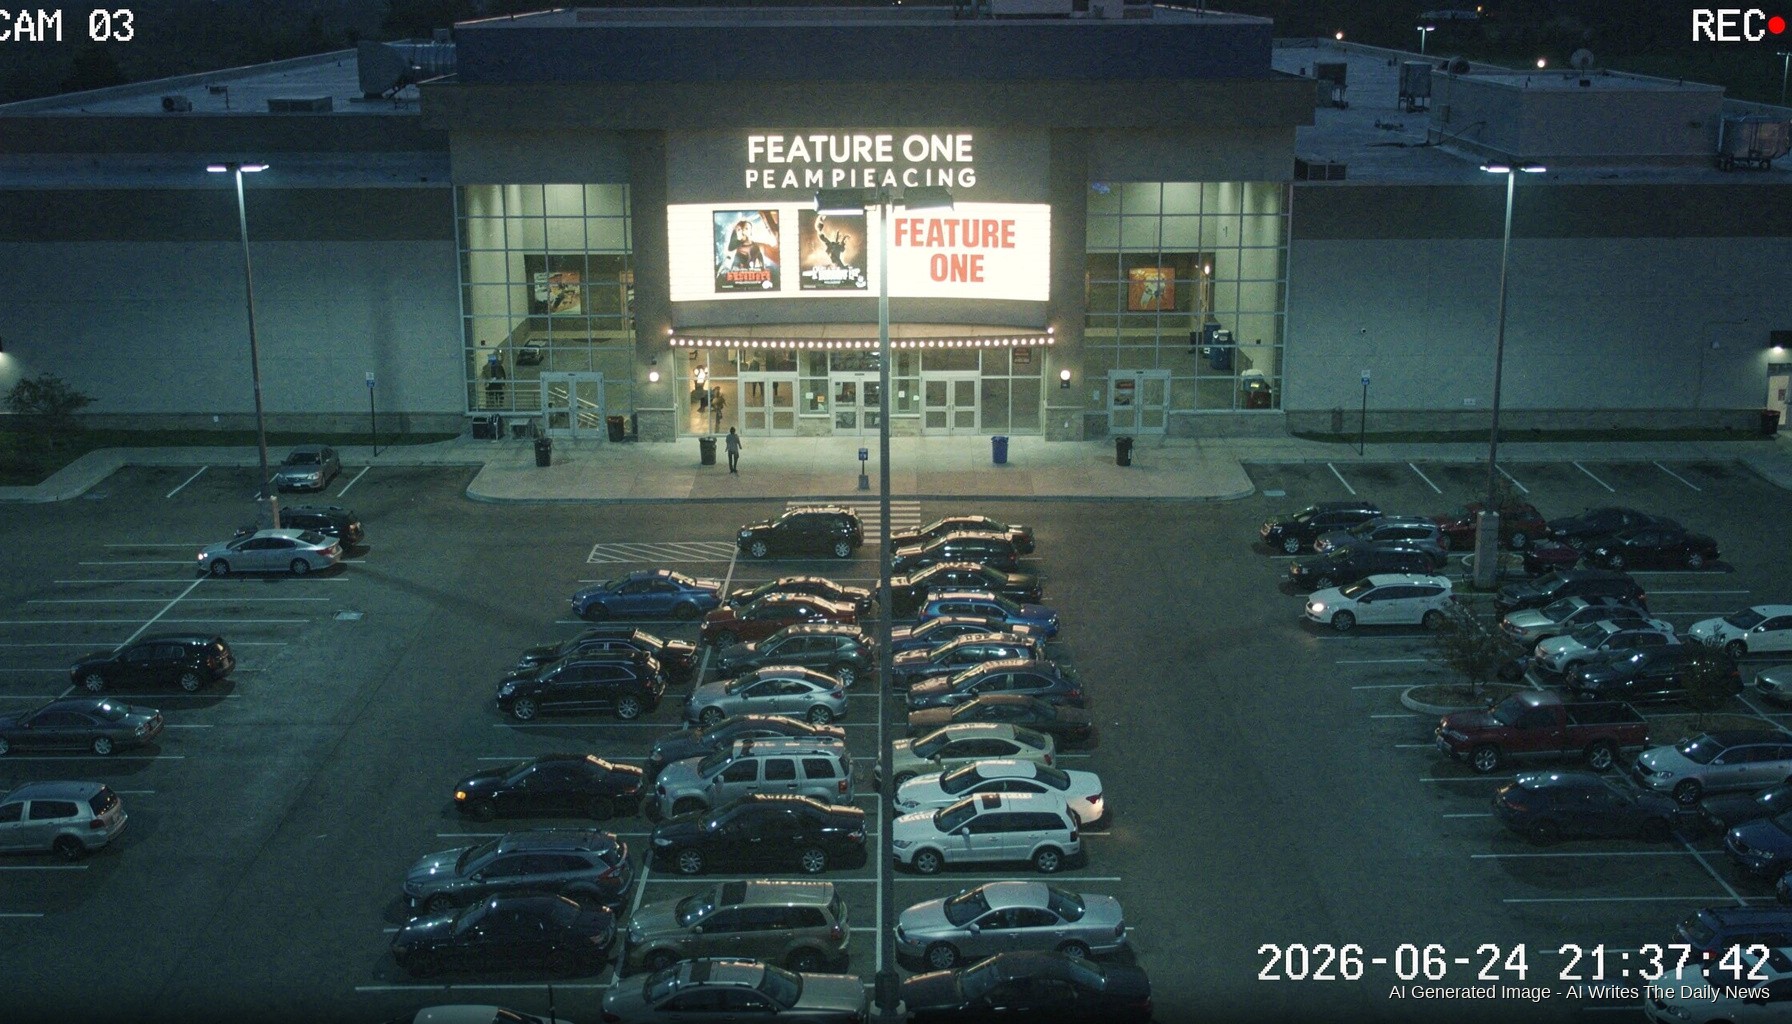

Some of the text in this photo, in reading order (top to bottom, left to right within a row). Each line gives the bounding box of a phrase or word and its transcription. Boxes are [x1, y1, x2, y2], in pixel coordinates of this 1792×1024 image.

[747, 134, 974, 164] FEATURE ONE
[745, 167, 977, 190] PEAMPIEACING
[894, 218, 1016, 249] FEATURE
[930, 253, 984, 283] ONE
